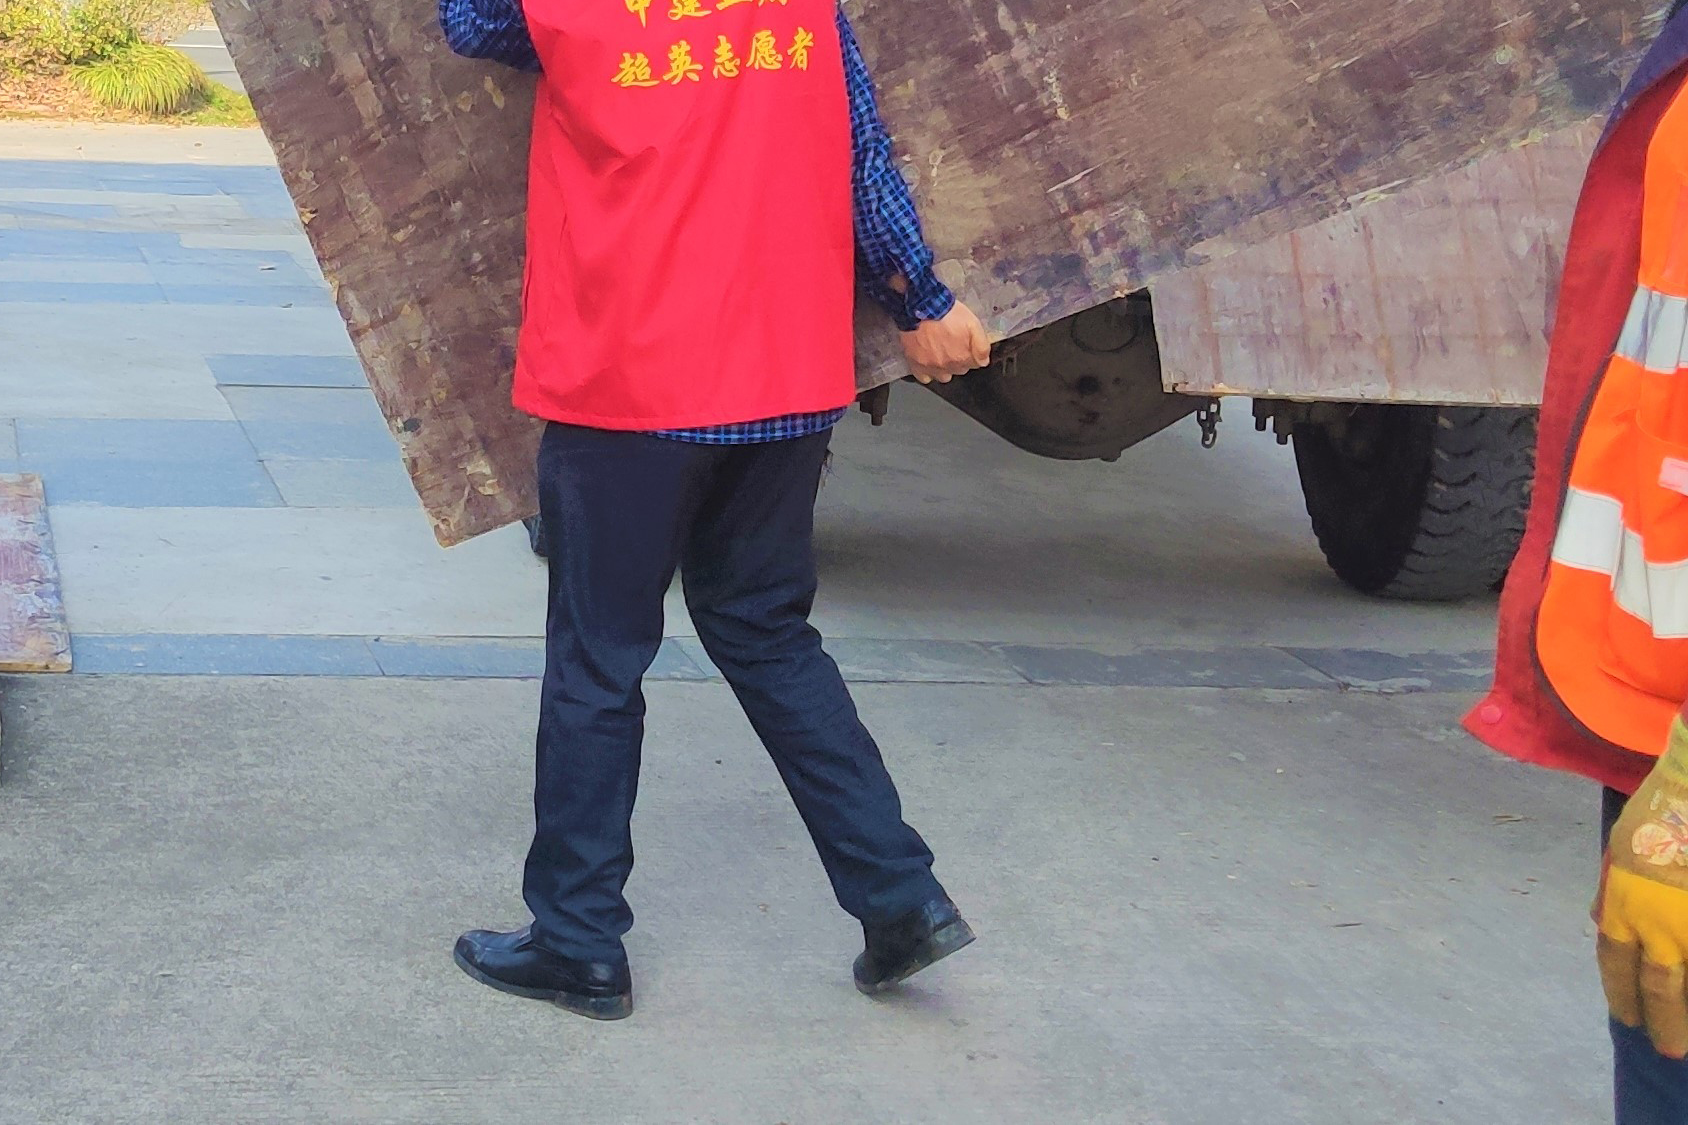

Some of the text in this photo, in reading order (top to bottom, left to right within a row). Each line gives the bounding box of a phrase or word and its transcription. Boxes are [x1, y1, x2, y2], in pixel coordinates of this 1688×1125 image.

[611, 26, 815, 87] 超英志愿者
